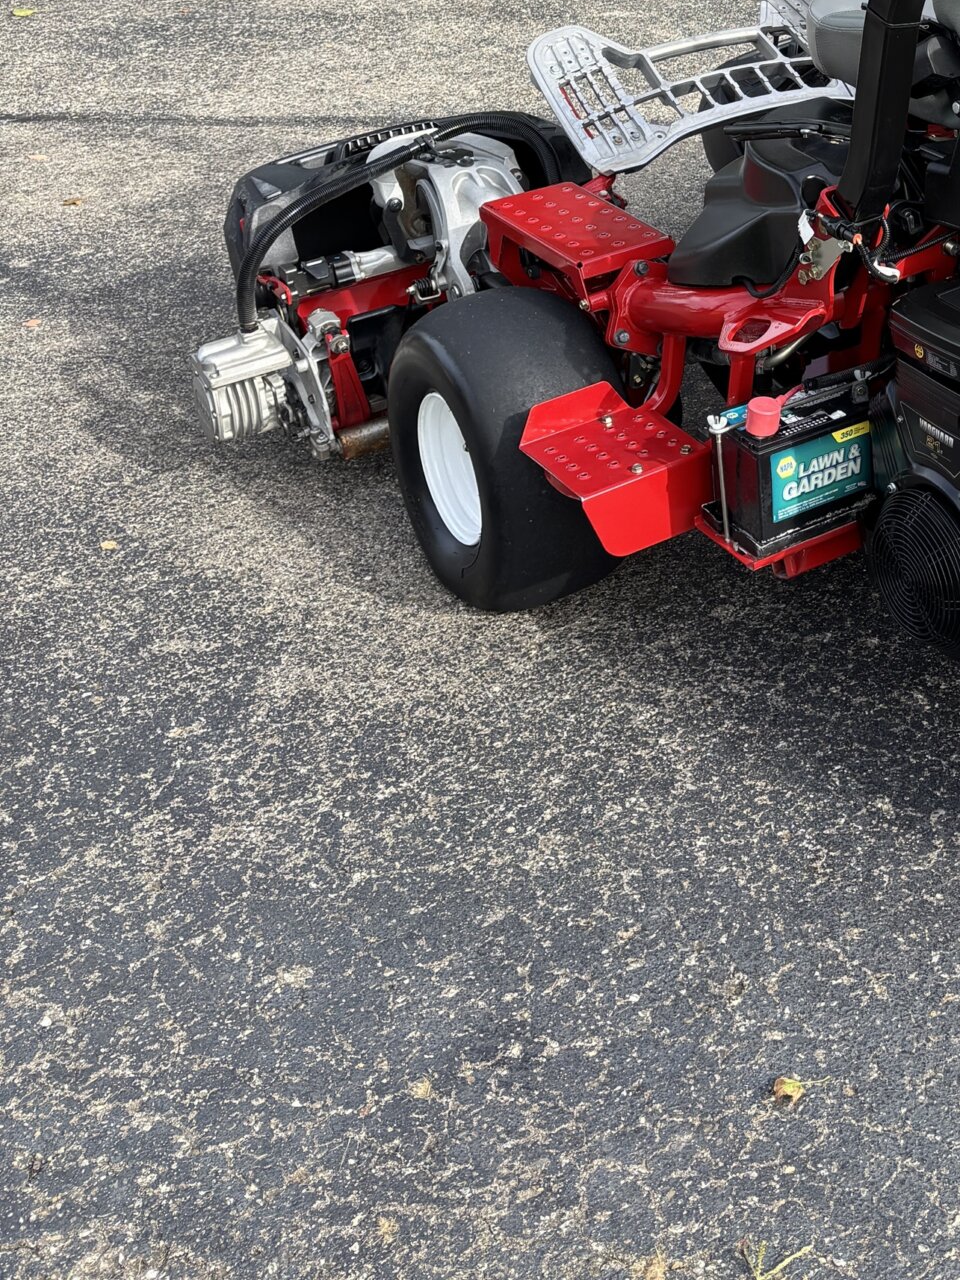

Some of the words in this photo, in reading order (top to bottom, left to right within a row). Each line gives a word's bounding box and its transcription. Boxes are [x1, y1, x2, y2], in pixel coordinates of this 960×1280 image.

[840, 429, 854, 440] 350
[919, 417, 954, 449] VANGUARD
[779, 461, 794, 473] NAPA
[798, 447, 845, 478] LAWN
[848, 443, 861, 459] &
[782, 457, 862, 501] GARDEN
